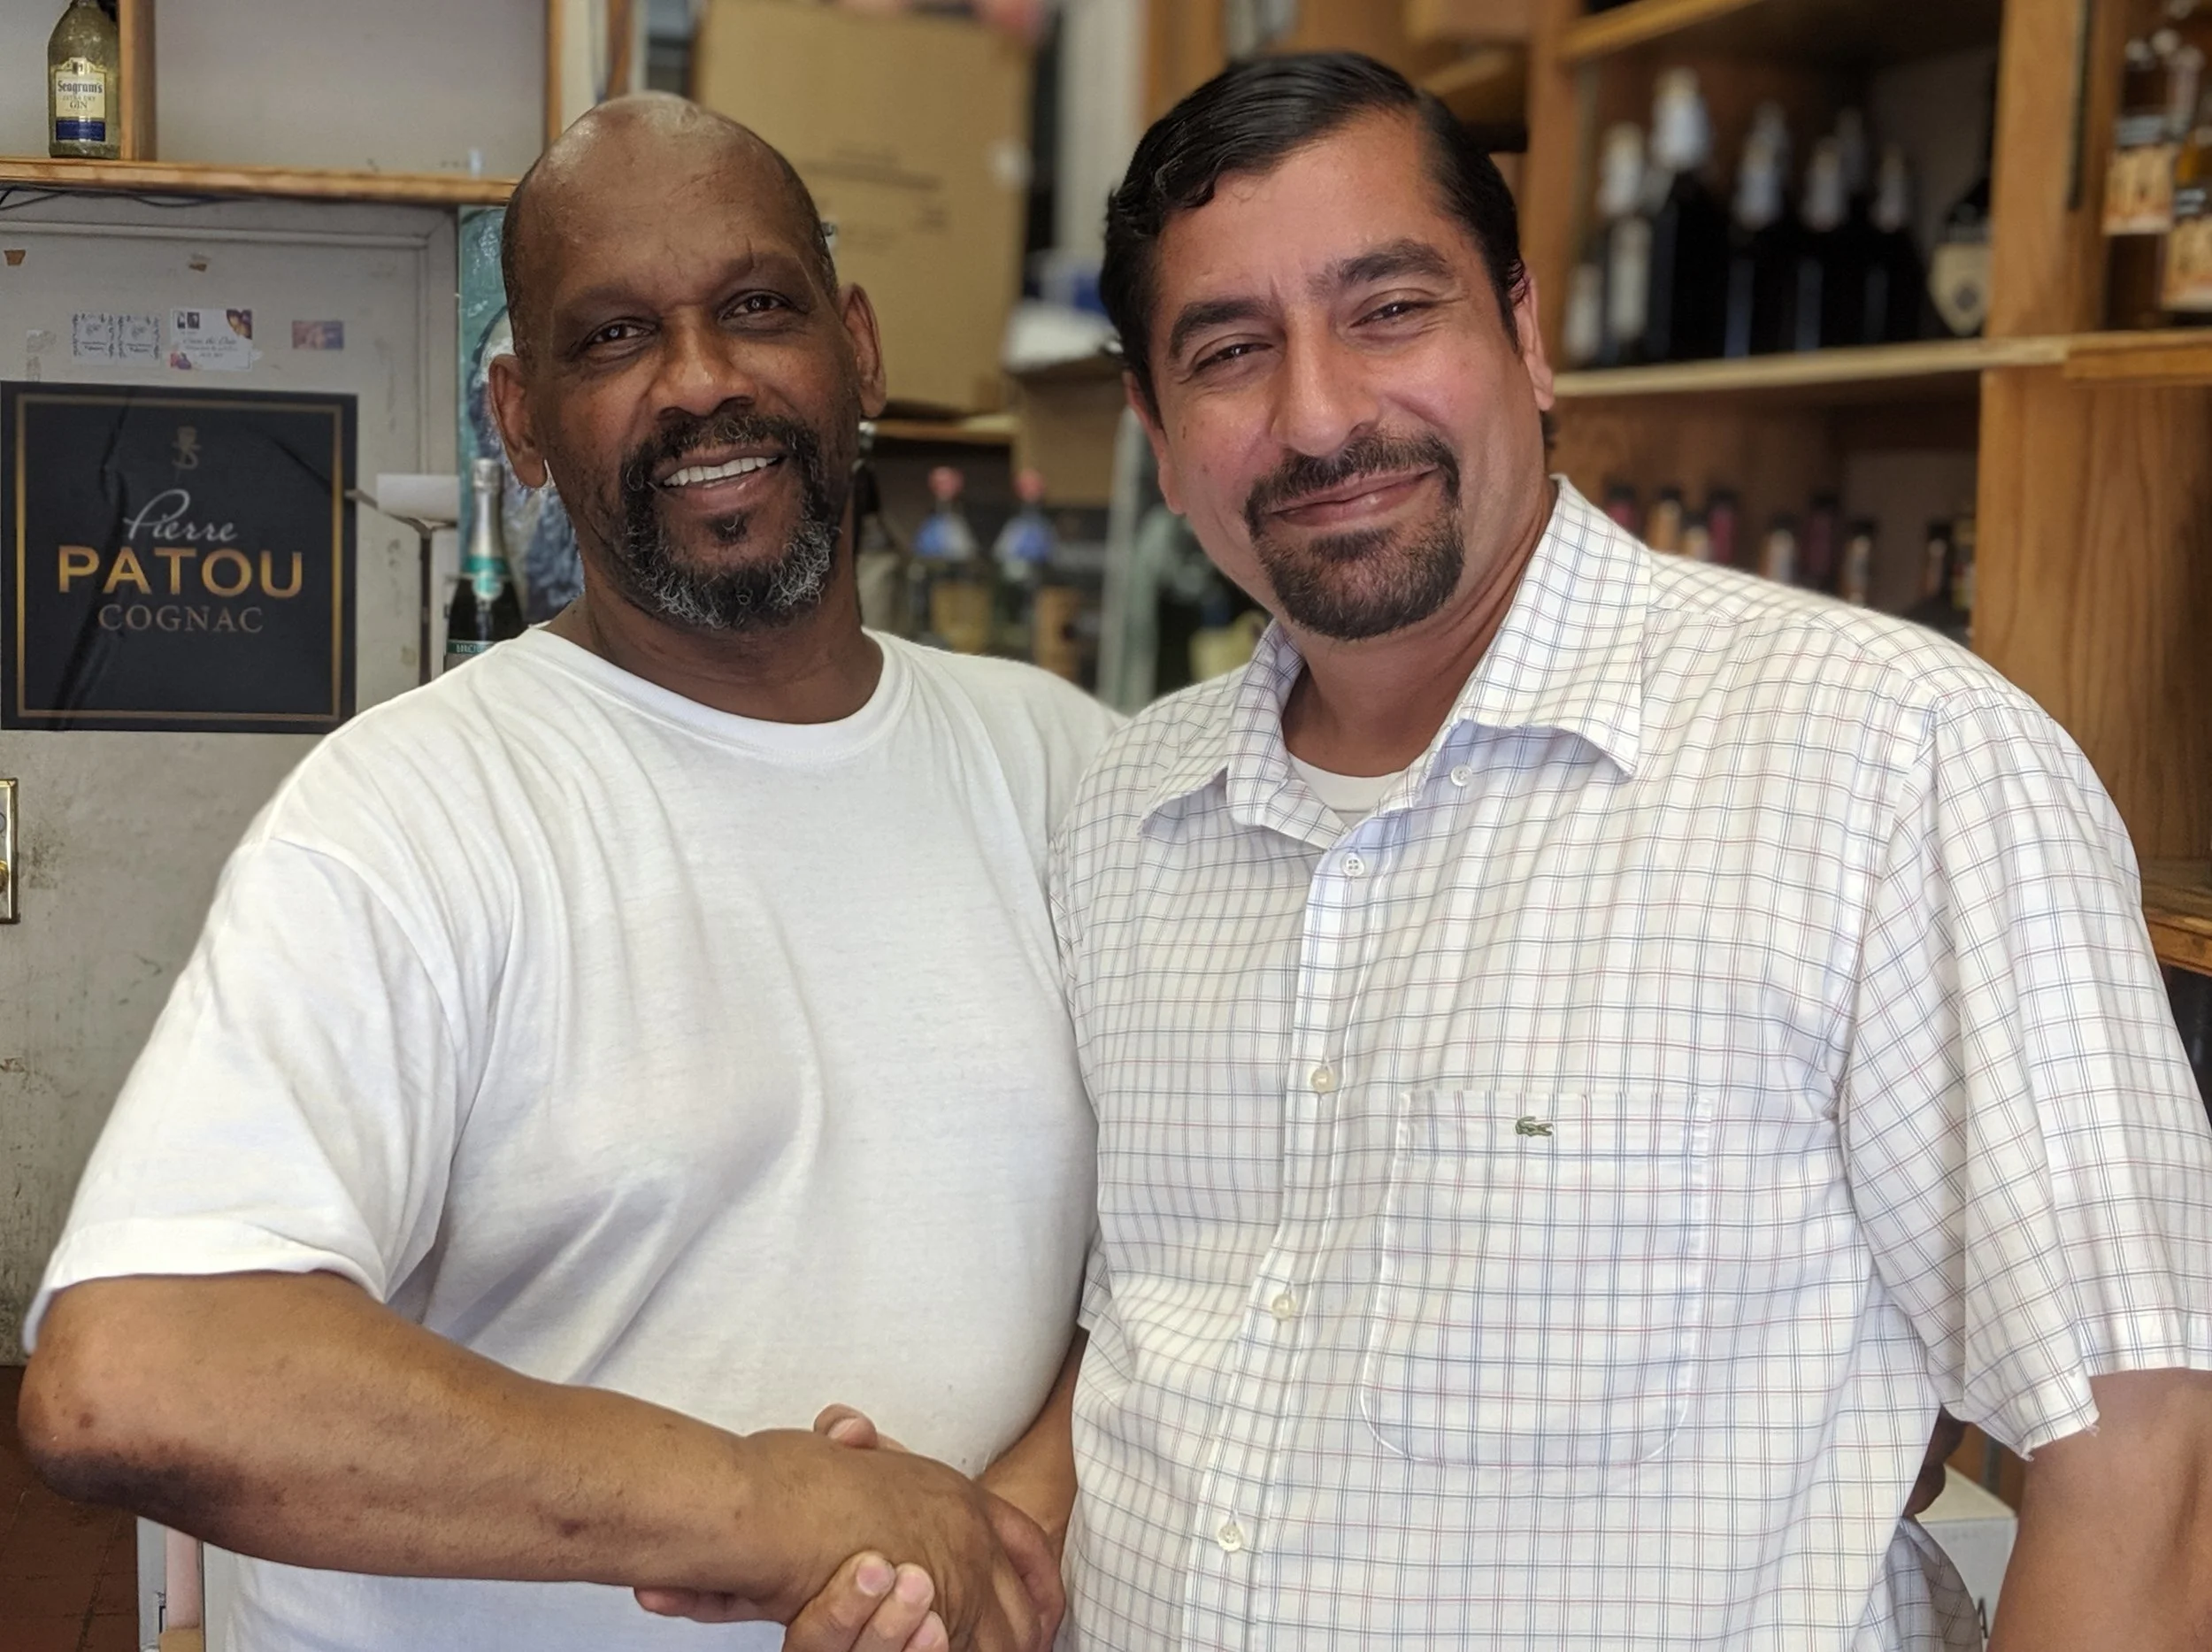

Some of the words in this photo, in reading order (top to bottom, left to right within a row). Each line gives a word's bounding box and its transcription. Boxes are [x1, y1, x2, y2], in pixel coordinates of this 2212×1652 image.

[58, 80, 104, 95] Seagram's
[70, 100, 88, 109] GIN
[122, 488, 238, 542] Pierre
[58, 544, 303, 598] PATOU
[97, 603, 264, 634] COGNAC
